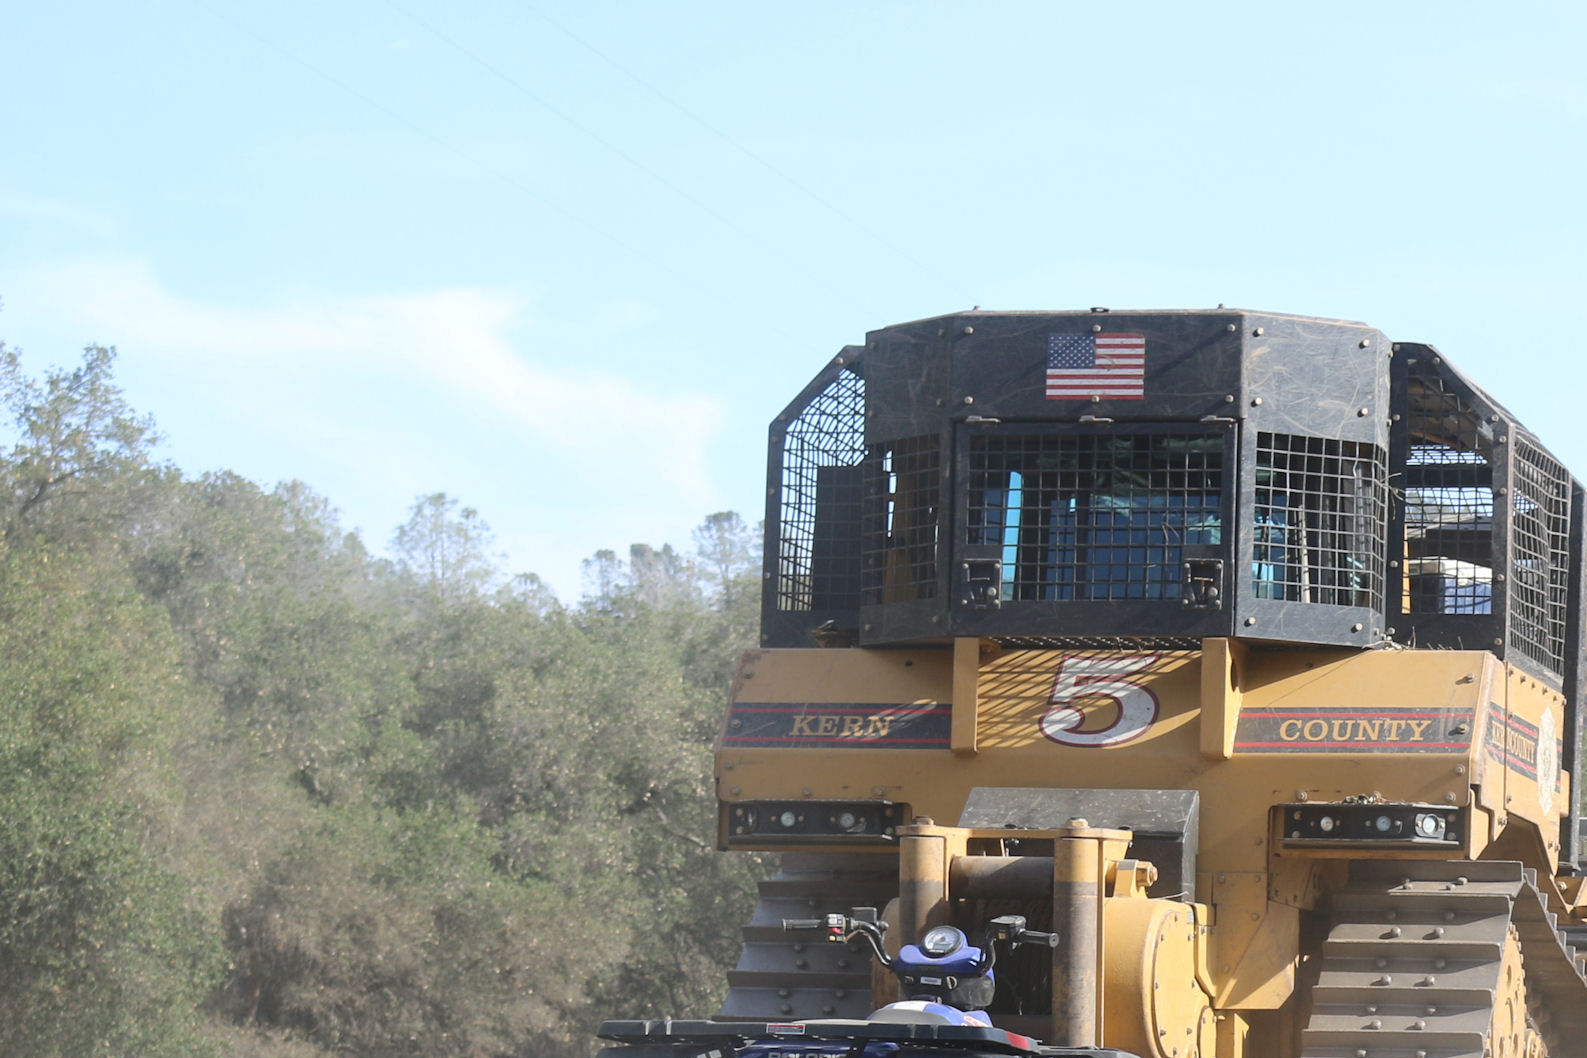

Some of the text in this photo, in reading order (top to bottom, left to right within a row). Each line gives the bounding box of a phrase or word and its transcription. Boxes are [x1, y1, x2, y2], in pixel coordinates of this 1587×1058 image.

[1038, 652, 1161, 748] 5
[788, 714, 895, 737] KERN
[1279, 718, 1432, 742] COUNTY
